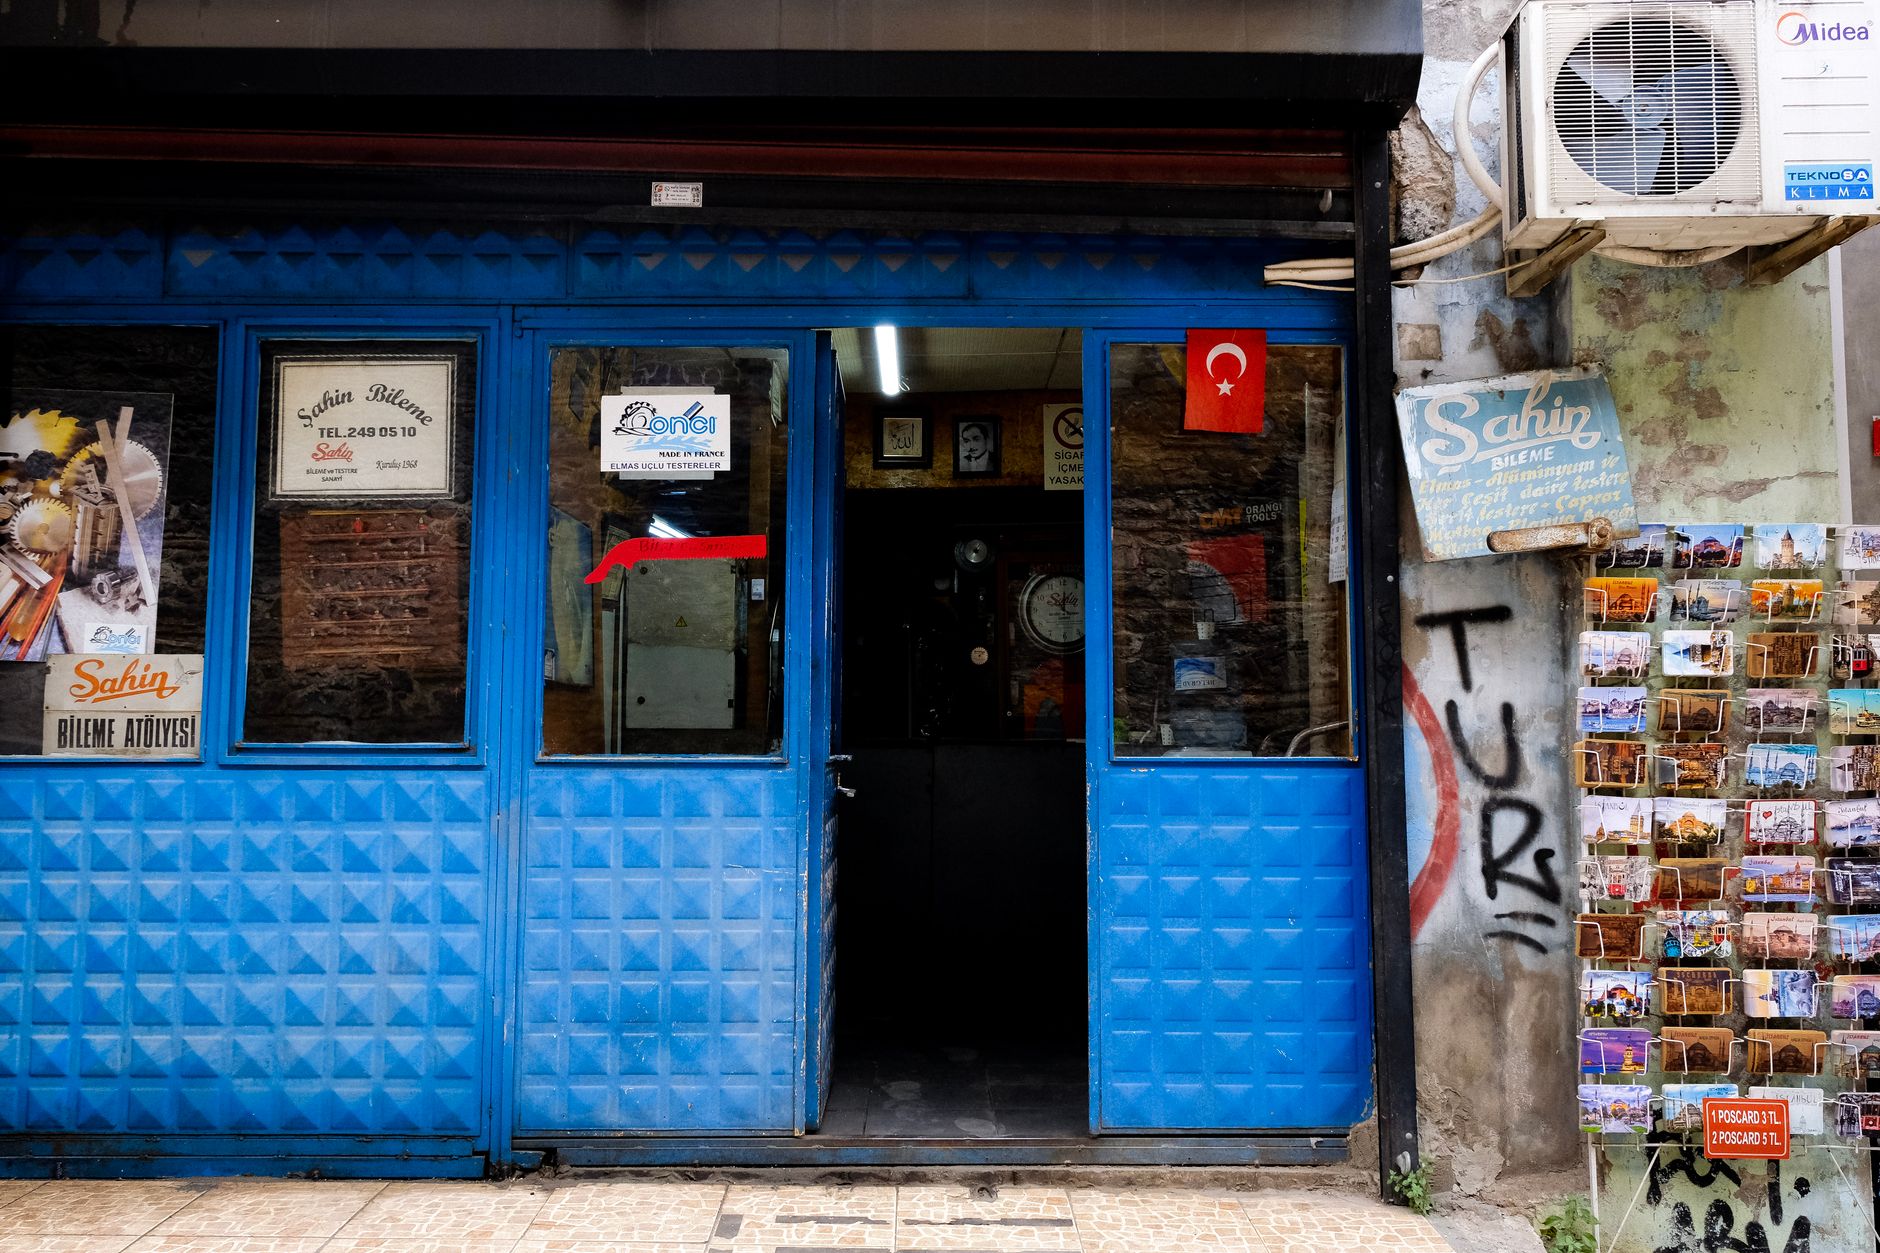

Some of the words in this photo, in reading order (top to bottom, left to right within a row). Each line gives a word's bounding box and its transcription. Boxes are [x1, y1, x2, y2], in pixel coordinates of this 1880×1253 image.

[1791, 22, 1869, 41] Midea
[1788, 169, 1869, 182] TEKNOSA
[298, 389, 354, 428] Şahin
[365, 384, 433, 426] Bileme
[402, 459, 418, 469] 1968
[1491, 445, 1556, 471] BİLEME
[666, 462, 721, 470] TESTERELER
[1246, 512, 1278, 523] TOOLS
[57, 715, 115, 748] BİLEME
[124, 715, 196, 748] ATÖLYESİ
[1712, 1110, 1716, 1124] 1
[1718, 1110, 1760, 1125] POSCARD
[1761, 1110, 1767, 1125] 3
[1768, 1110, 1782, 1125] TL.
[1712, 1132, 1718, 1144] 2
[1719, 1132, 1761, 1145] POSCARD
[1762, 1132, 1768, 1146] 5
[1769, 1132, 1782, 1146] TL.
